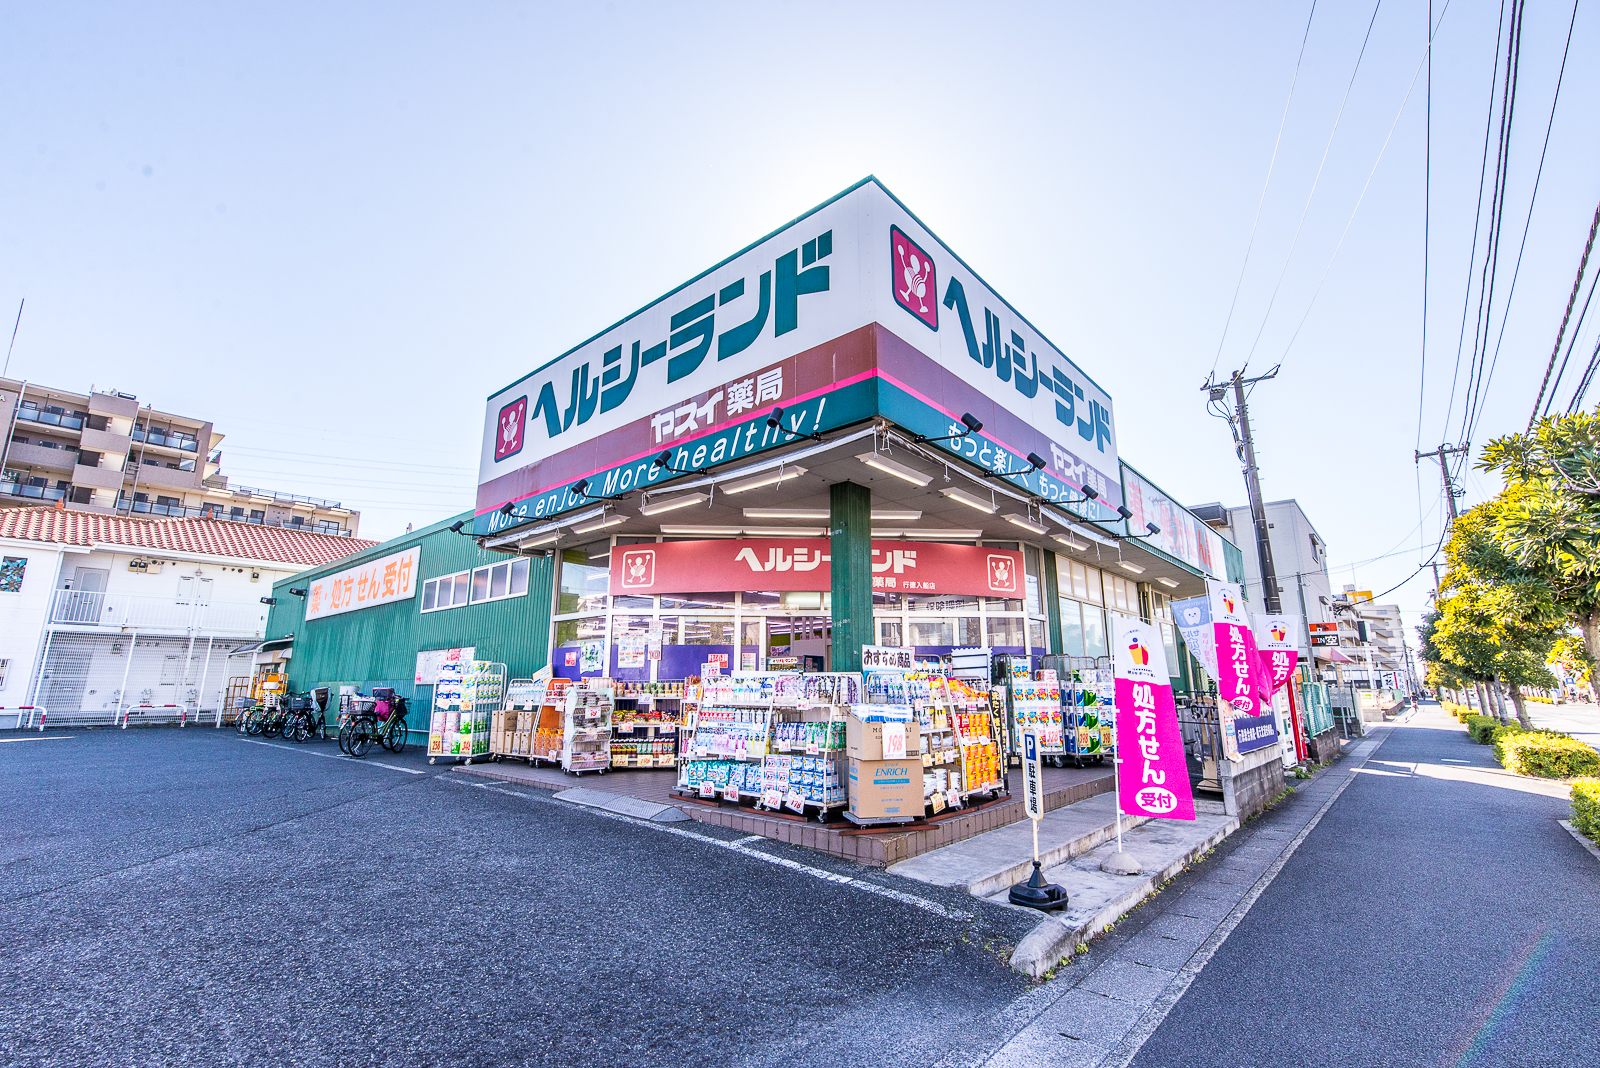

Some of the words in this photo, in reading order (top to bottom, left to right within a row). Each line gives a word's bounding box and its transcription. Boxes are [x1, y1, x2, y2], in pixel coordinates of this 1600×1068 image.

[532, 229, 832, 438] ヘルシーランド
[943, 275, 1112, 453] ヘルシーランド
[651, 366, 783, 444] ヤスイ薬局
[602, 461, 660, 492] More
[1050, 442, 1107, 499] ヤスイ薬局
[734, 547, 917, 574] ヘルシーンド
[863, 649, 911, 668] おすすめ商品
[1229, 624, 1250, 695] 処方せん
[1271, 651, 1290, 686] 処方
[888, 734, 903, 754] 198
[1026, 736, 1034, 758] P
[1132, 683, 1166, 785] 処方せん
[875, 768, 908, 777] ENRICH
[1028, 762, 1038, 814] 駐車場
[1140, 792, 1172, 809] 受付
